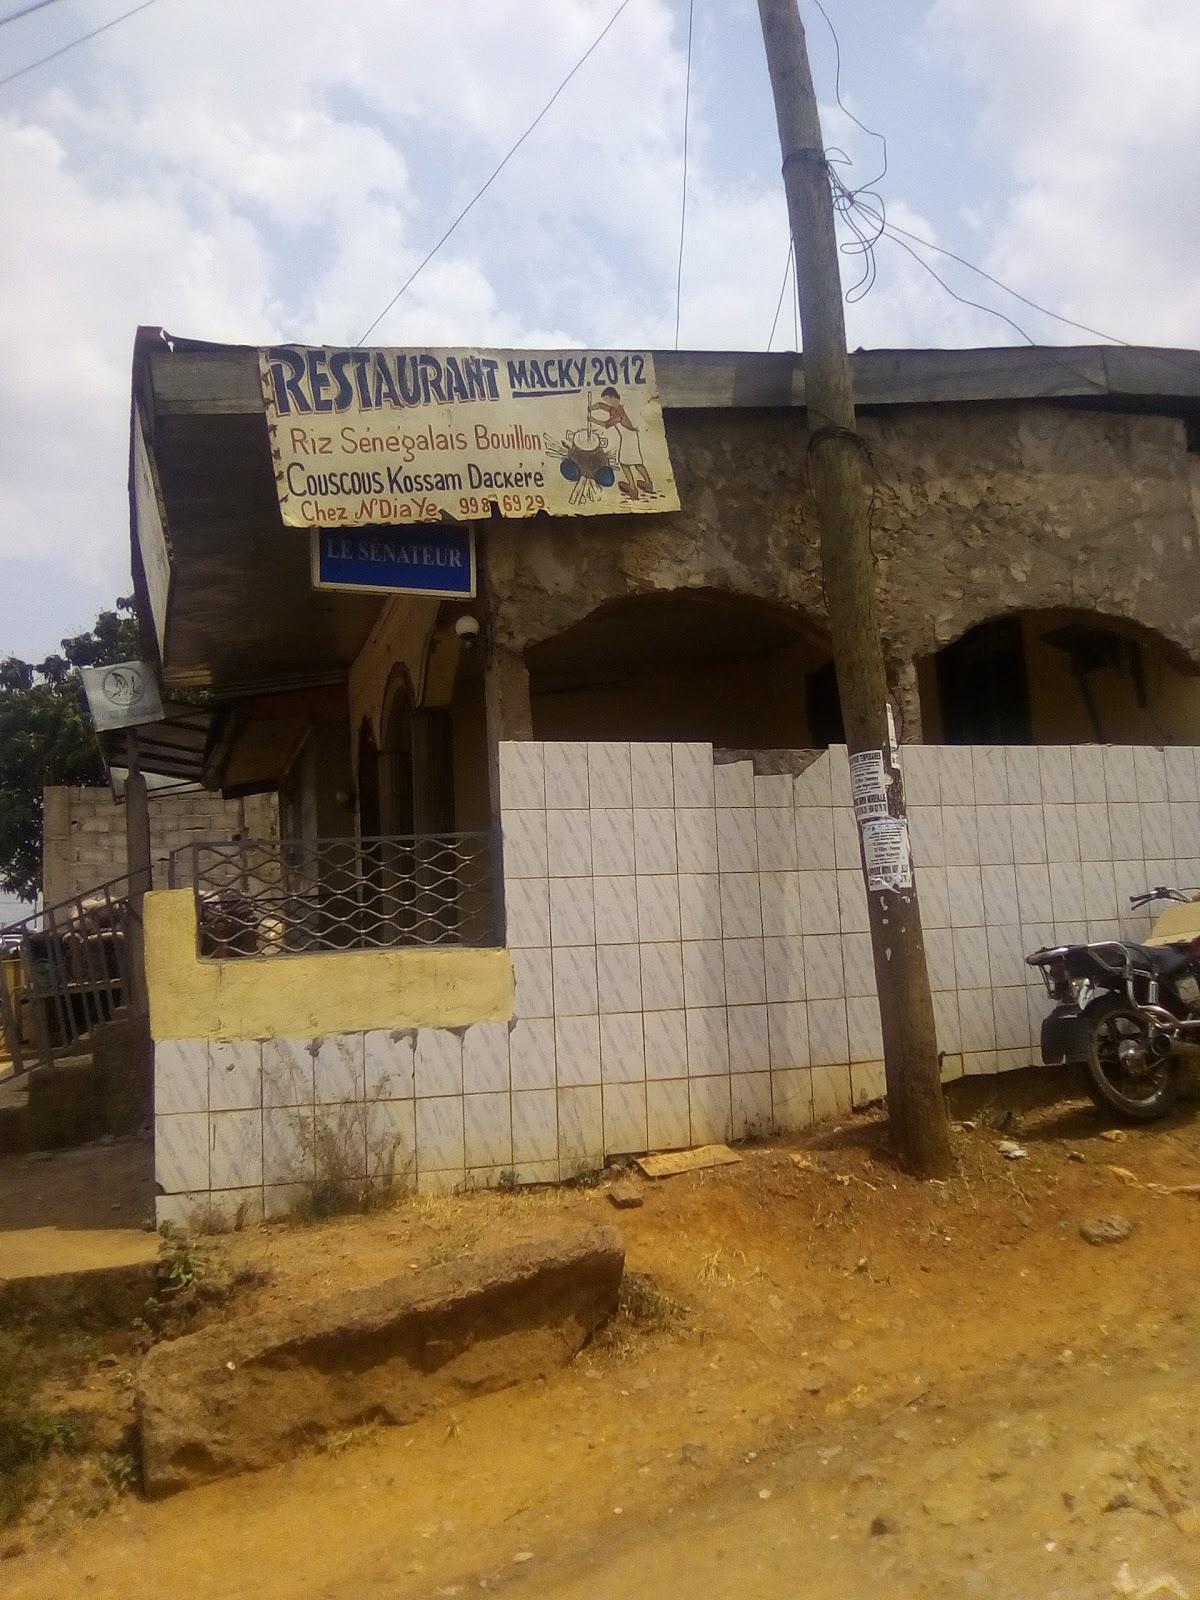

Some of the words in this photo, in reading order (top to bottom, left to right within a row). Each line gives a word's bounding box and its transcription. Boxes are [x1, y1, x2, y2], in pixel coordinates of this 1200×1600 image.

[268, 348, 501, 416] RESTAURANT
[290, 427, 333, 455] Riz
[340, 425, 468, 462] Sénégalais
[474, 424, 541, 451] Bouillon
[386, 465, 462, 493] Kossam
[467, 462, 545, 489] Dackéré
[301, 500, 348, 521] Chez
[327, 537, 353, 559] LE
